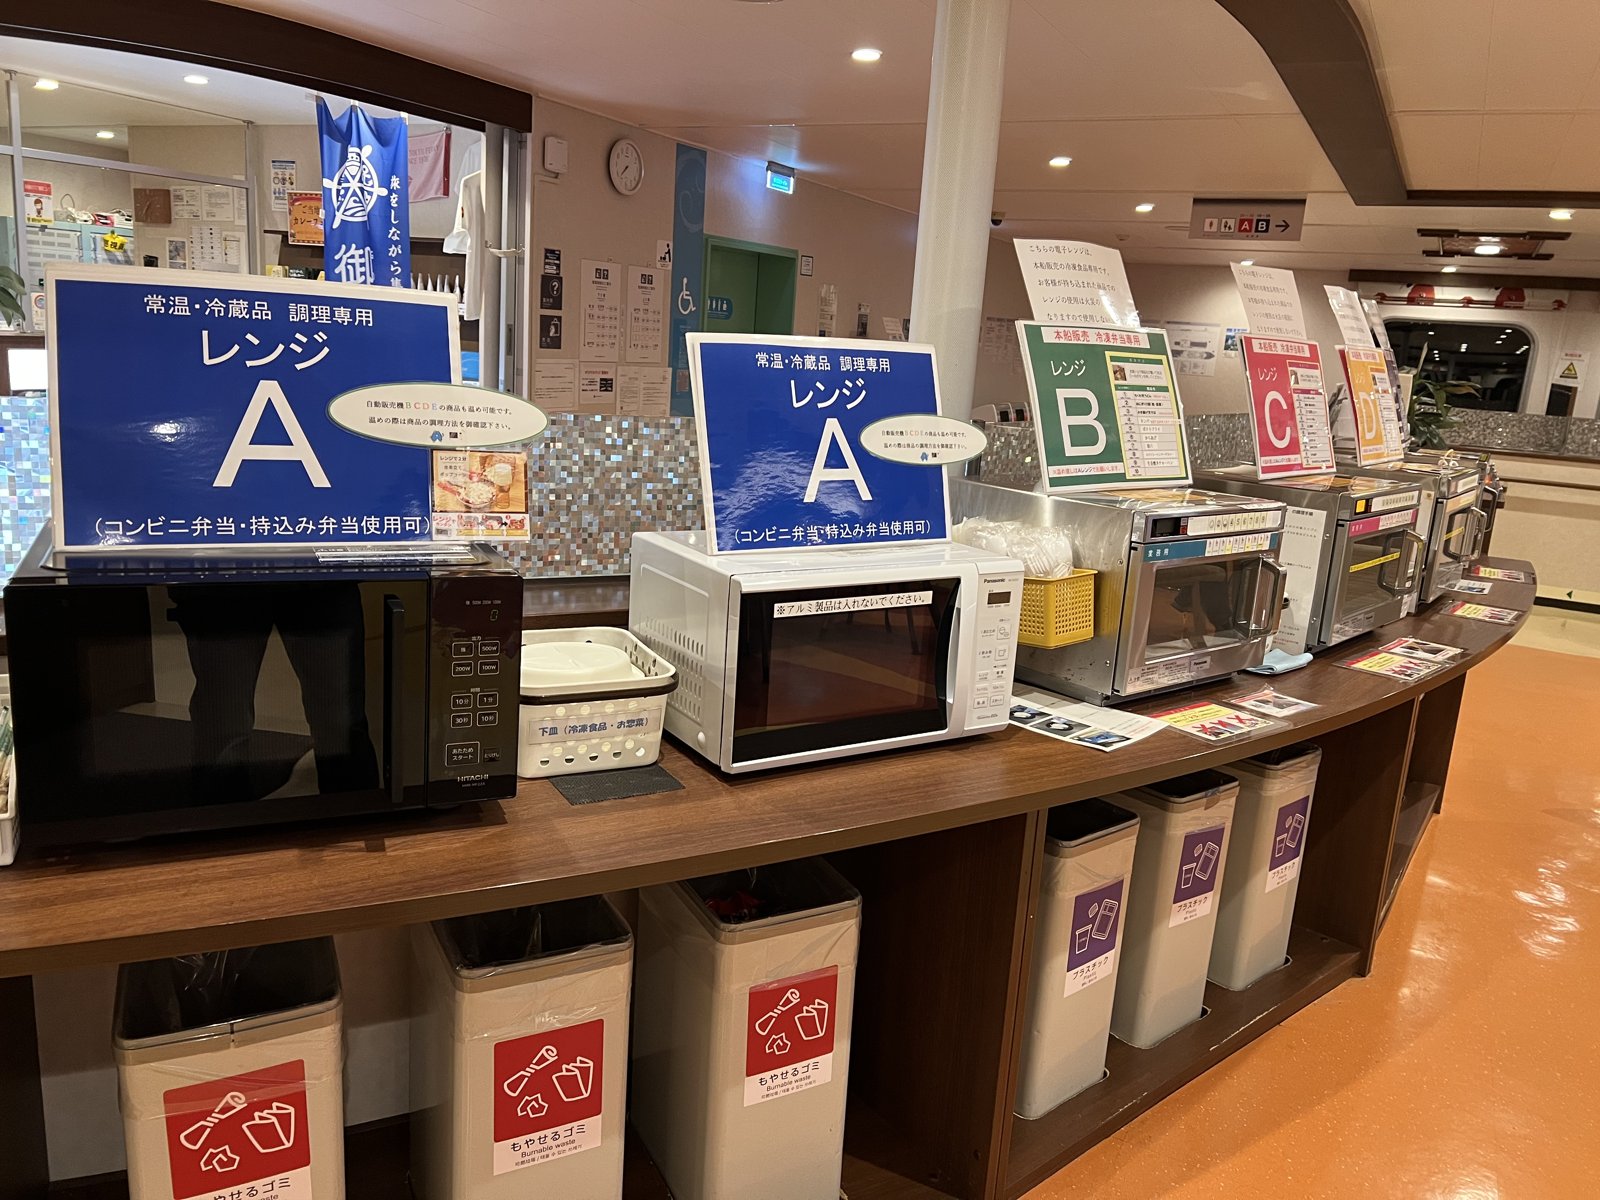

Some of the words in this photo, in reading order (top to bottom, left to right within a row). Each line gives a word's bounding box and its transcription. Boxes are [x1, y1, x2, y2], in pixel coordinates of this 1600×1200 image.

[1241, 221, 1250, 230] A
[1258, 221, 1267, 231] B
[143, 295, 272, 321] 常温・冷蔵品
[288, 303, 375, 327] 調理専用
[202, 330, 330, 371] レンジ
[755, 351, 831, 371] 常温・冷蔵品
[839, 356, 891, 373] 調理専用
[1050, 359, 1086, 377] レンジ
[1258, 366, 1278, 381] レンジ
[789, 378, 867, 410] レンジ
[1056, 388, 1106, 457] B
[1265, 390, 1291, 448] C
[1360, 391, 1376, 440] D
[212, 380, 332, 489] A
[803, 417, 873, 503] A
[776, 593, 926, 616] ※アルミ製品は入れないでください。
[457, 774, 489, 782] HITACHI
[1177, 896, 1208, 913] プラスチック
[1072, 956, 1109, 981] プラスチック
[758, 1061, 820, 1087] もやせるゴミ
[766, 1079, 793, 1092] Burnable
[794, 1074, 811, 1084] waste
[510, 1123, 587, 1153] もやせるゴミ
[521, 1144, 553, 1159] Burnable
[555, 1139, 576, 1149] waste
